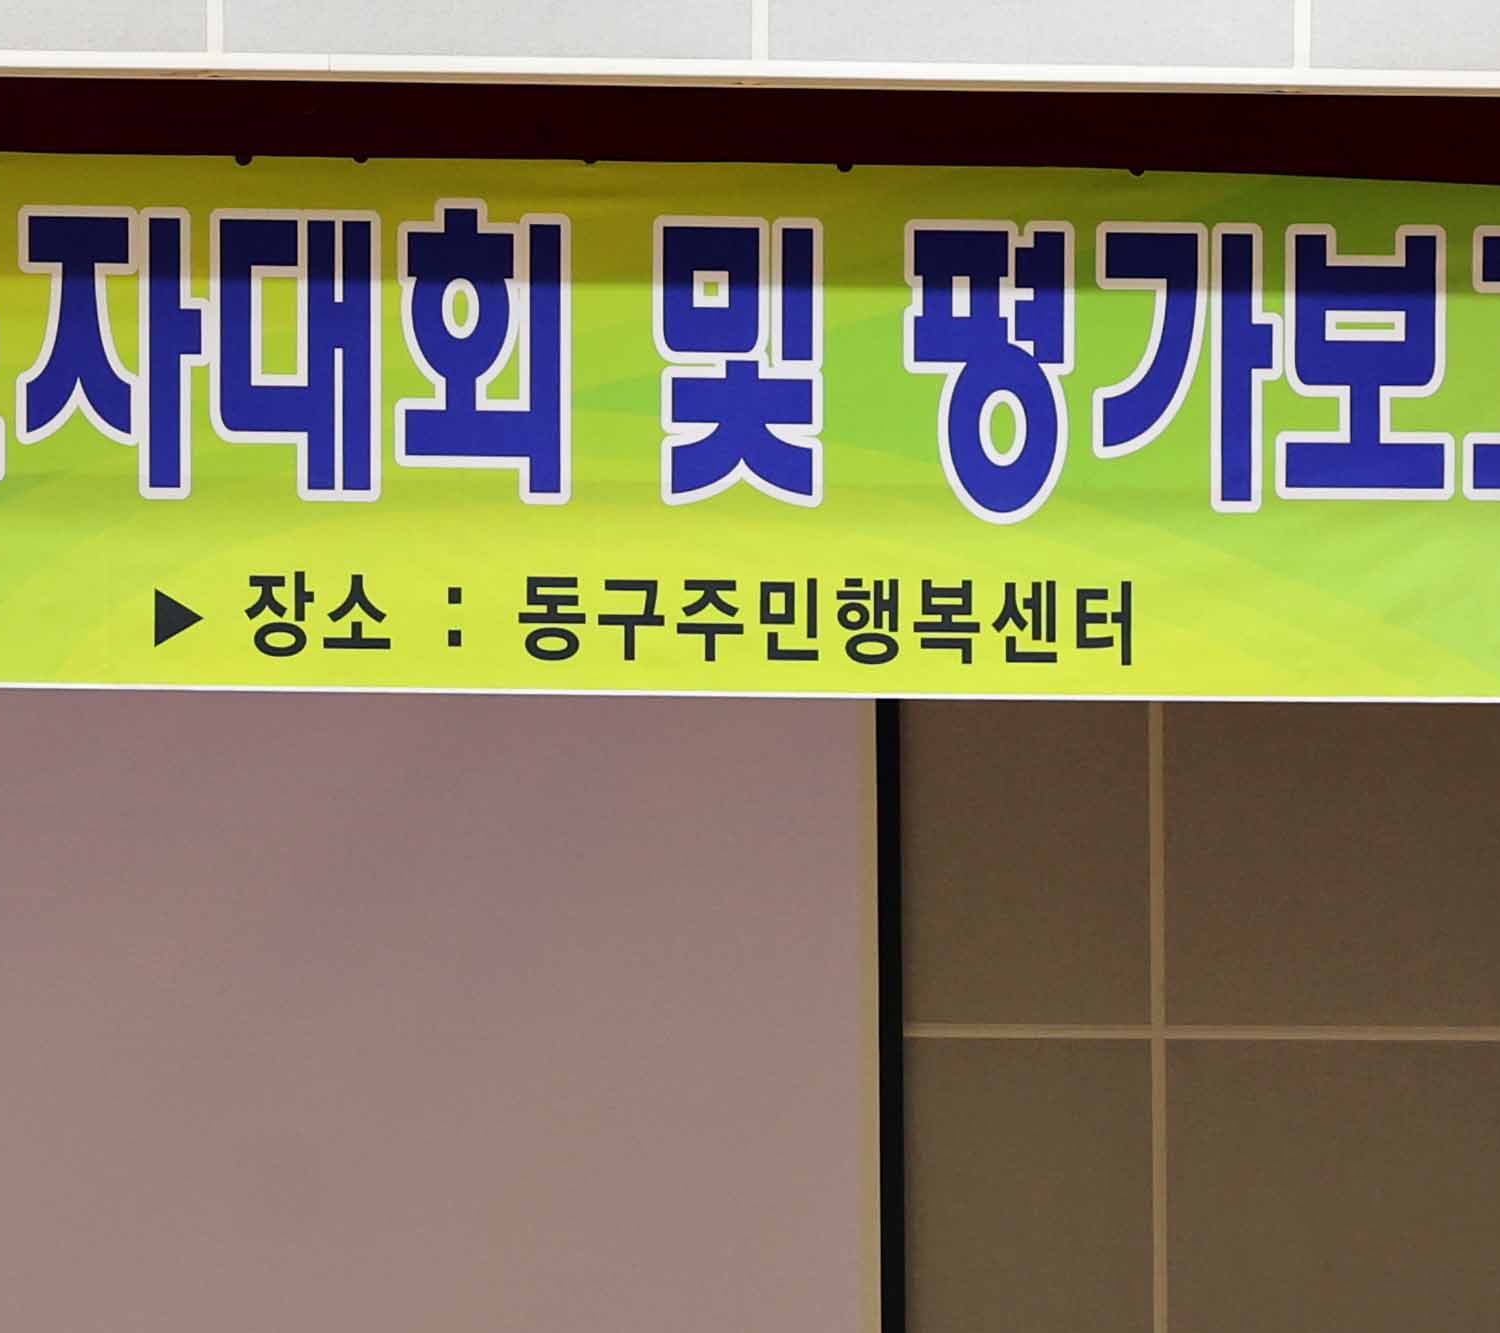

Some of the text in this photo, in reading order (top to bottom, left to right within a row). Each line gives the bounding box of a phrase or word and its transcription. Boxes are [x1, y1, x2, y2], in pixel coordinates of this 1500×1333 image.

[658, 220, 818, 502] 및
[243, 570, 1134, 667] 장소 : 동구주민행복센터
